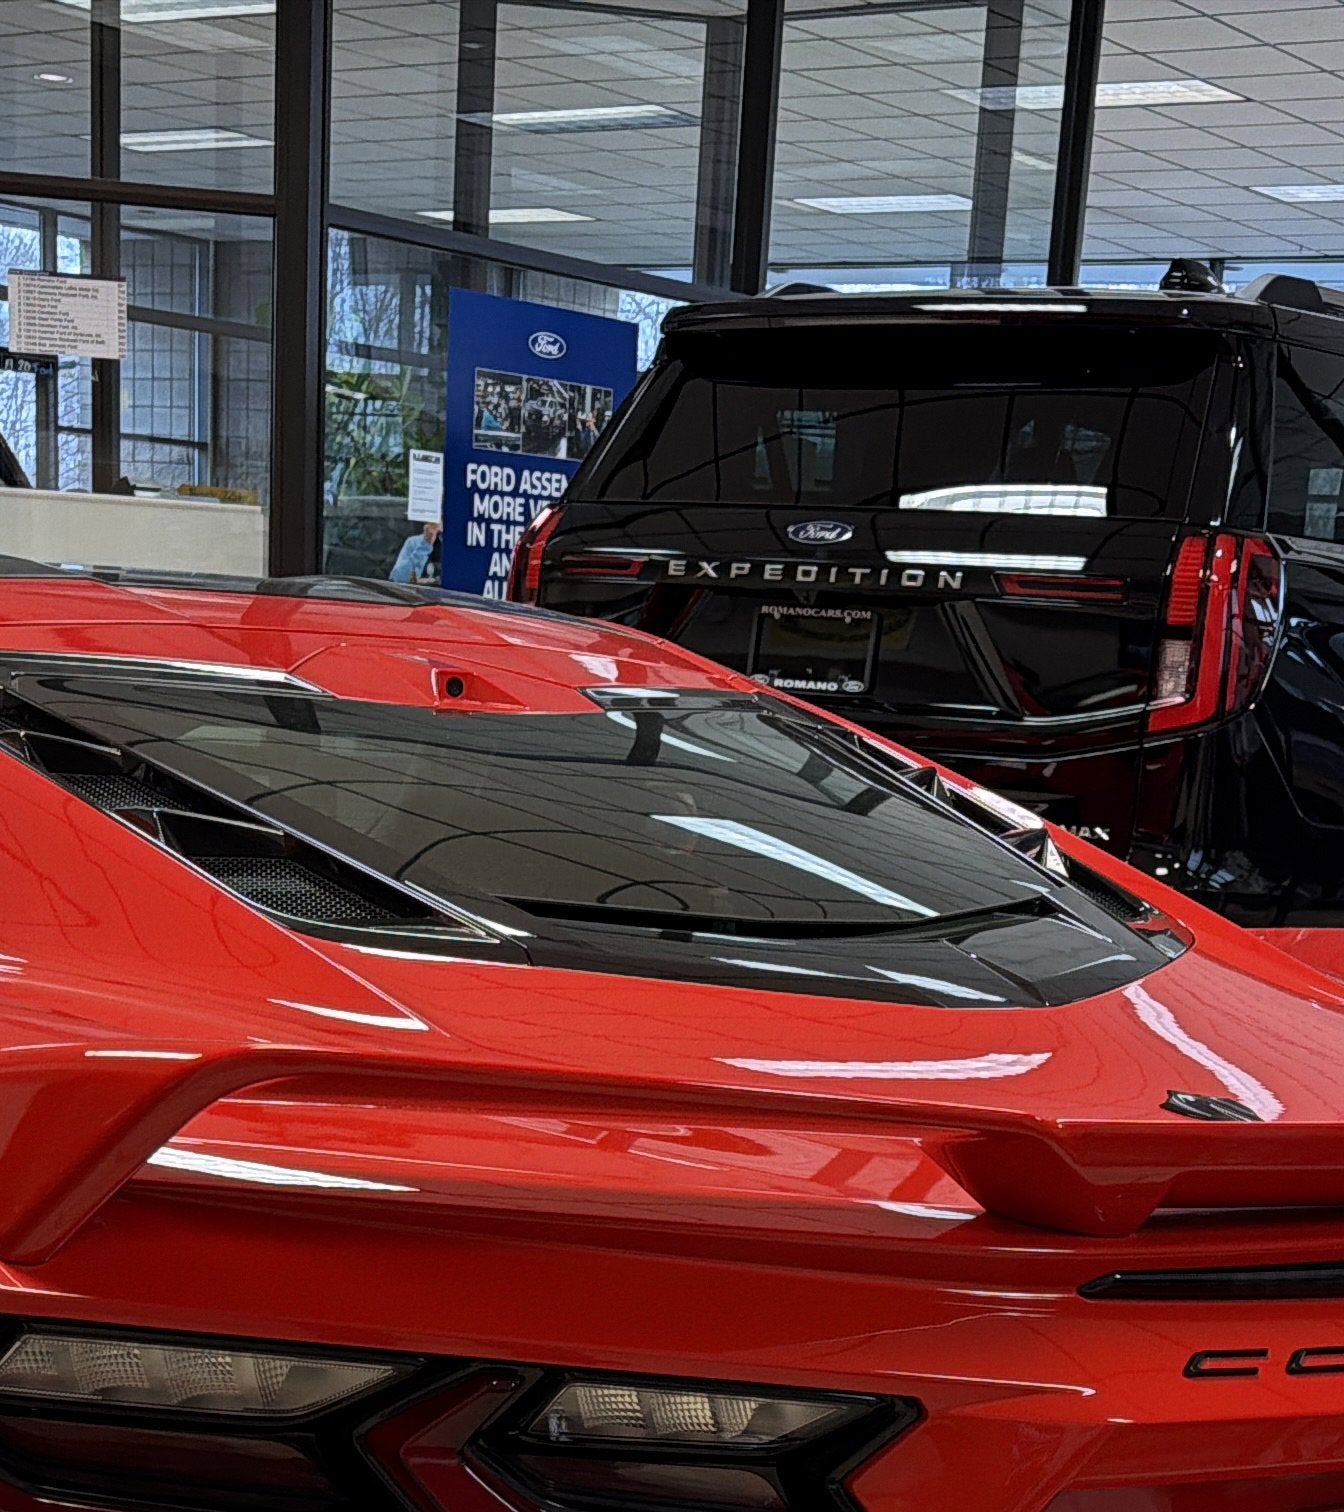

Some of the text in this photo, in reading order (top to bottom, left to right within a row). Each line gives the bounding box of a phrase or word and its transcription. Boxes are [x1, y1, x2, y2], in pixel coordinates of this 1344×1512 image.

[531, 334, 562, 356] Ford
[17, 359, 32, 372] 20
[466, 463, 516, 492] FORD
[473, 492, 525, 522] MORE
[467, 521, 525, 550] IN THE
[794, 522, 847, 542] Ford
[488, 551, 513, 578] AN
[668, 559, 964, 590] EXPEDITION
[483, 579, 509, 601] AU
[761, 605, 872, 620] ROMANOCARS.COM
[773, 678, 838, 692] ROMANO
